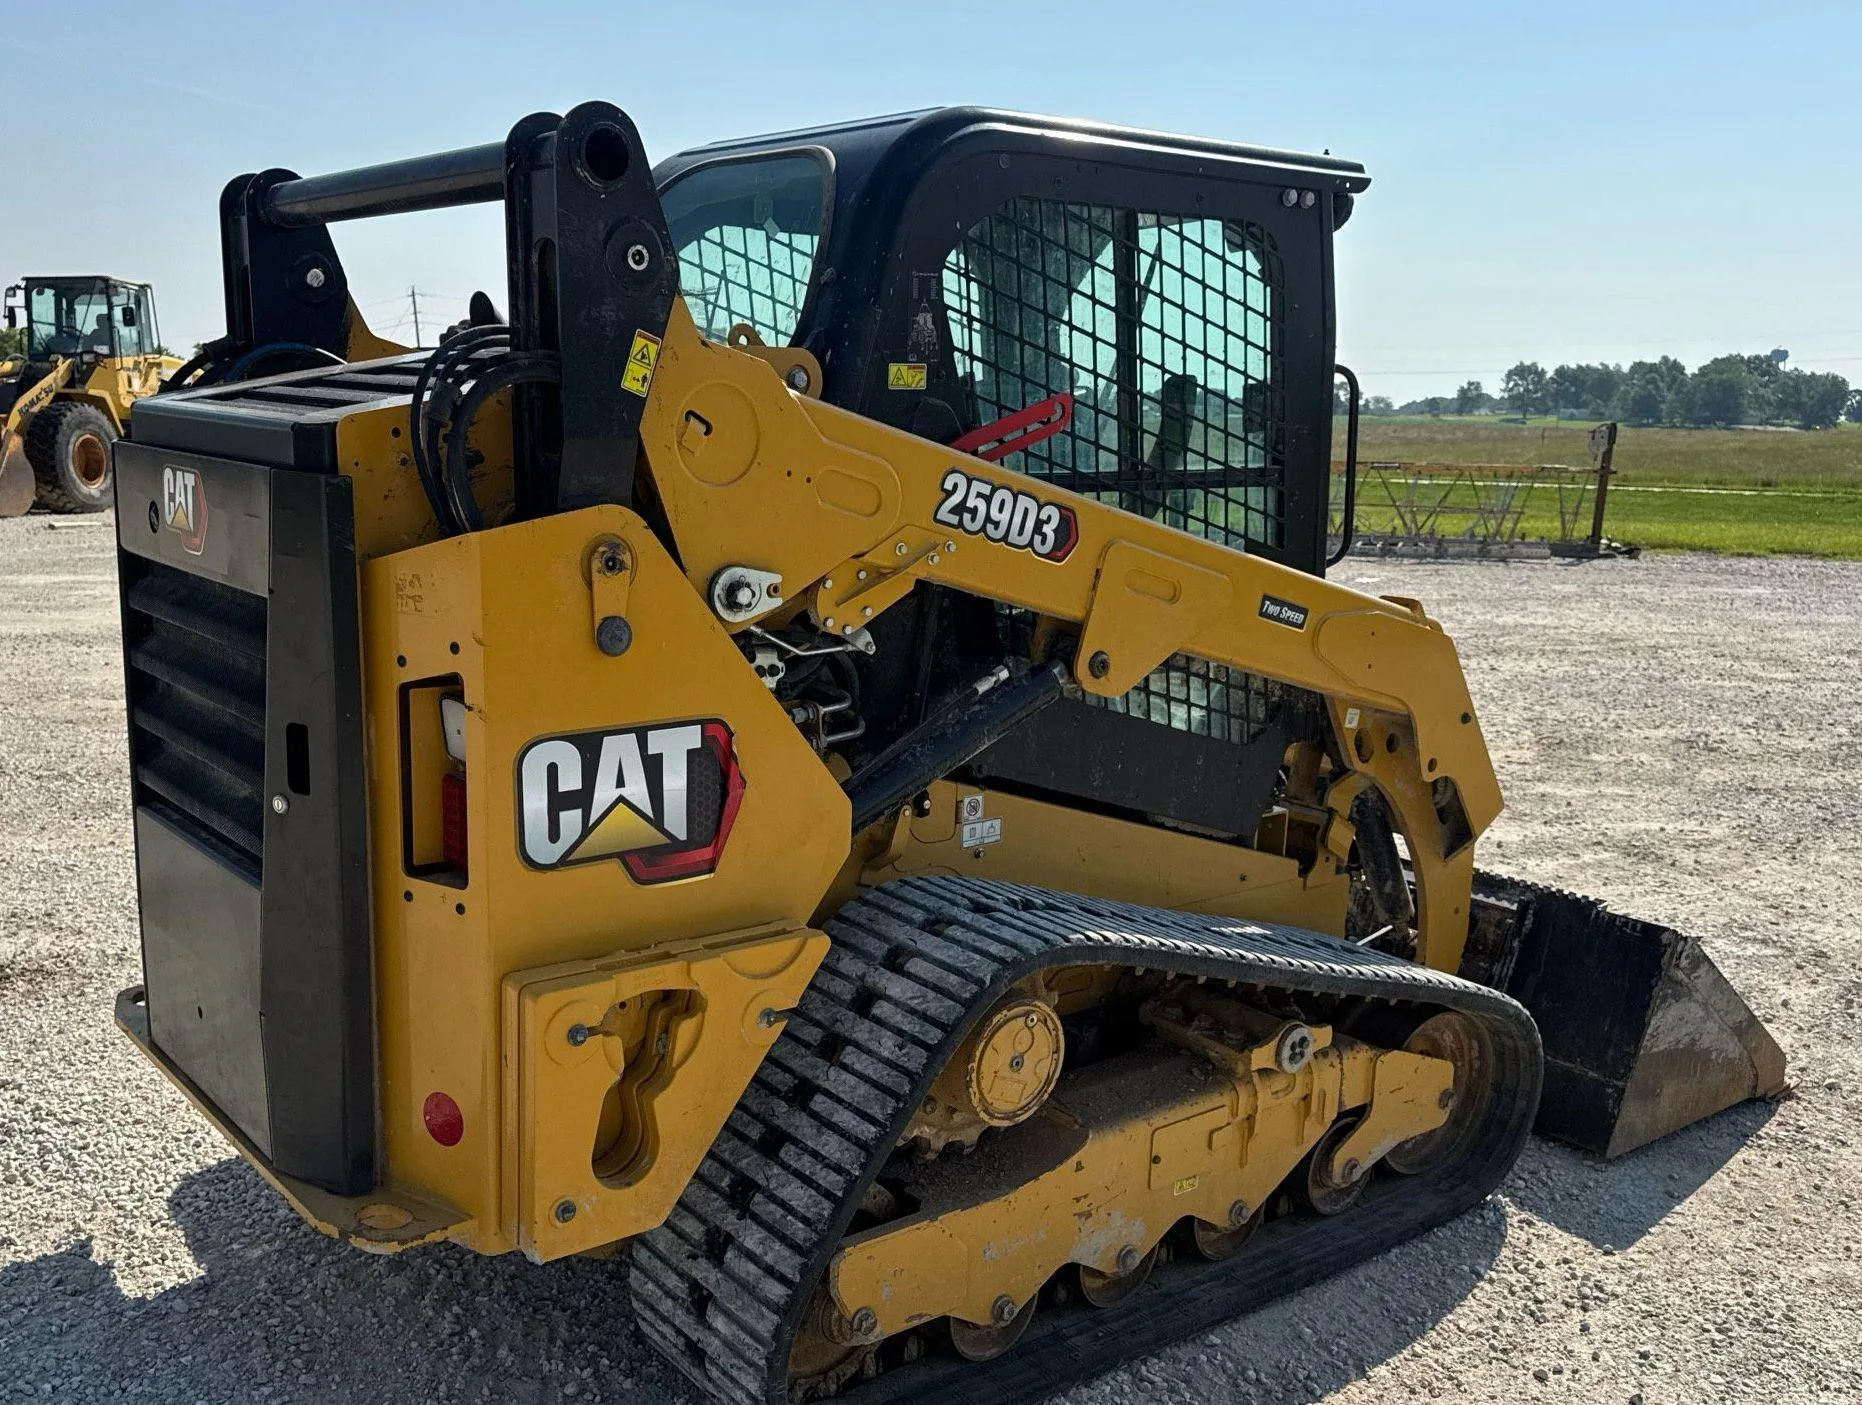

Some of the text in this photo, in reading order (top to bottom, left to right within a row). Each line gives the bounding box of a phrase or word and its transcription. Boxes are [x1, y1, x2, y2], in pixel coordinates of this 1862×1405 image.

[163, 467, 195, 533] CAT
[936, 472, 1060, 554] 259D3
[521, 724, 702, 865] CAT
